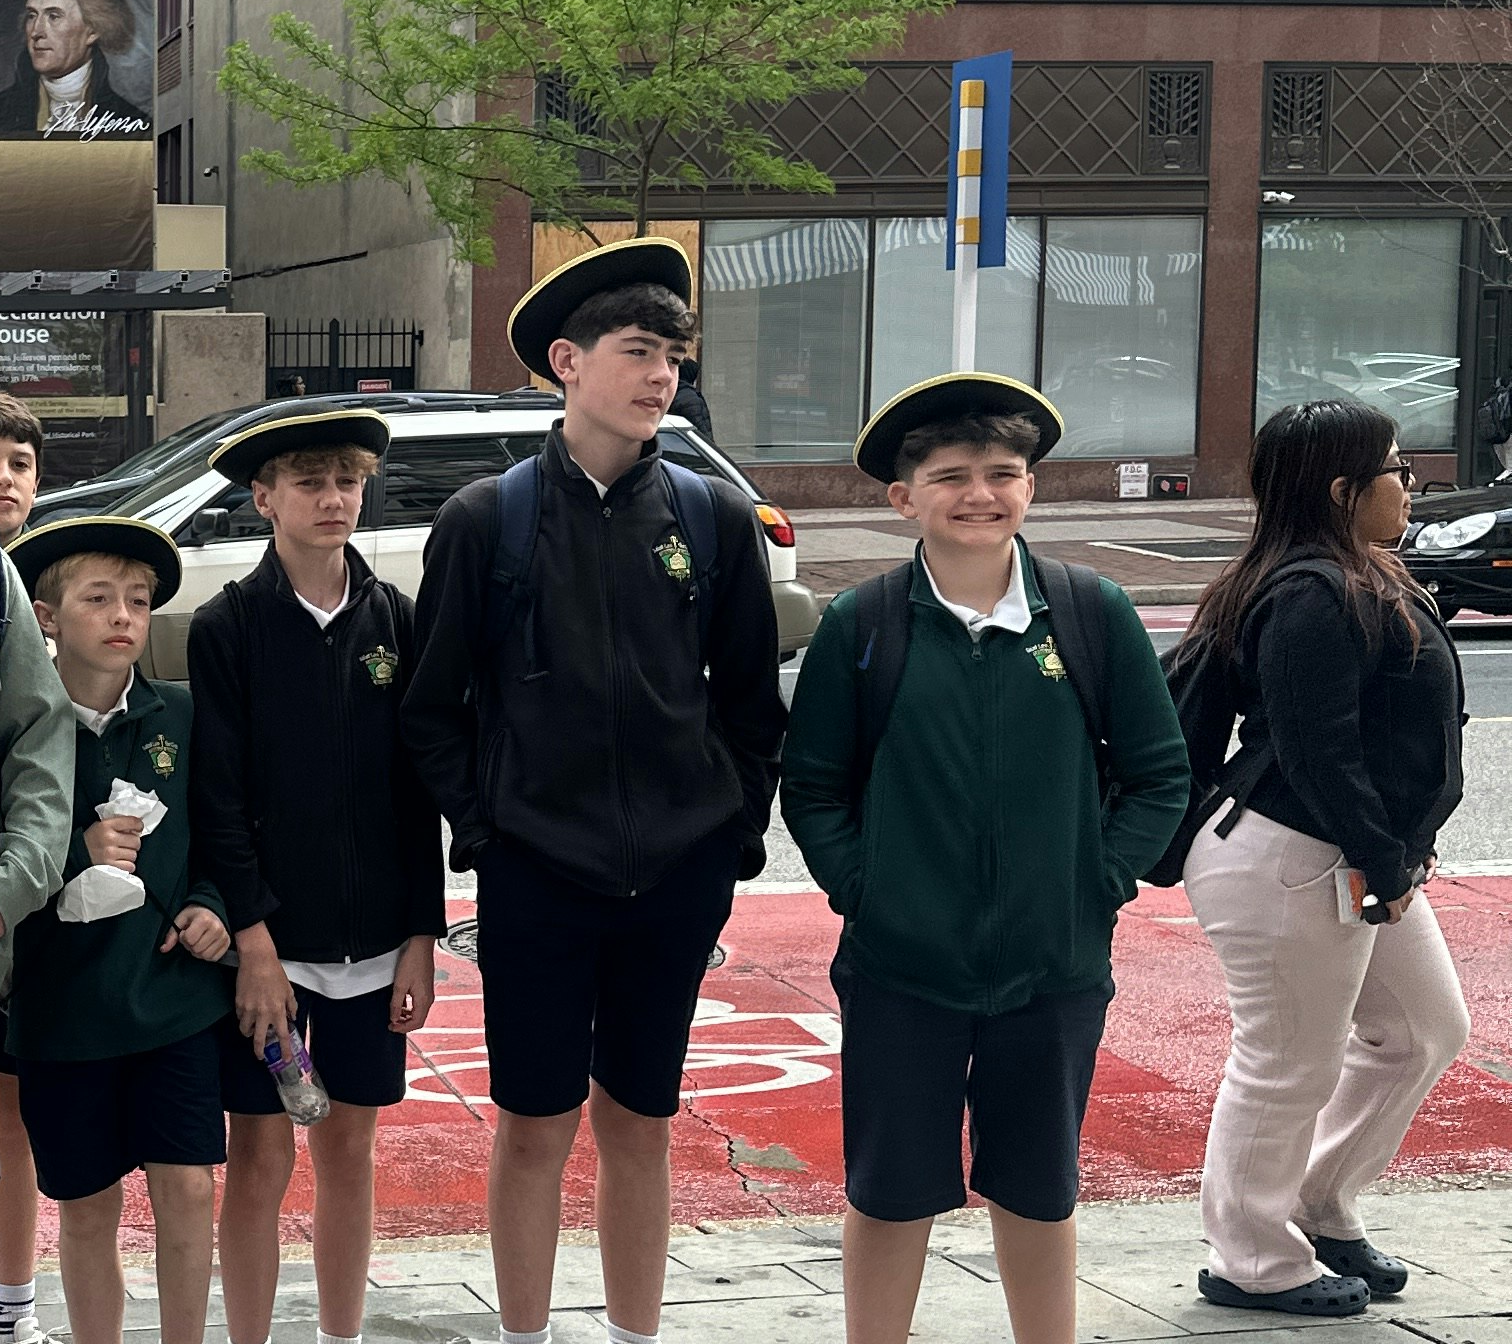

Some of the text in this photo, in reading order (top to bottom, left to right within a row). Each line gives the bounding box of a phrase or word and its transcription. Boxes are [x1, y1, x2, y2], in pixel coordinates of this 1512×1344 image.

[12, 352, 47, 363] Jefferson
[48, 353, 77, 364] penned
[78, 353, 92, 361] the
[25, 363, 35, 372] of
[36, 363, 90, 374] Independence
[10, 375, 20, 383] in
[51, 431, 81, 439] Historical
